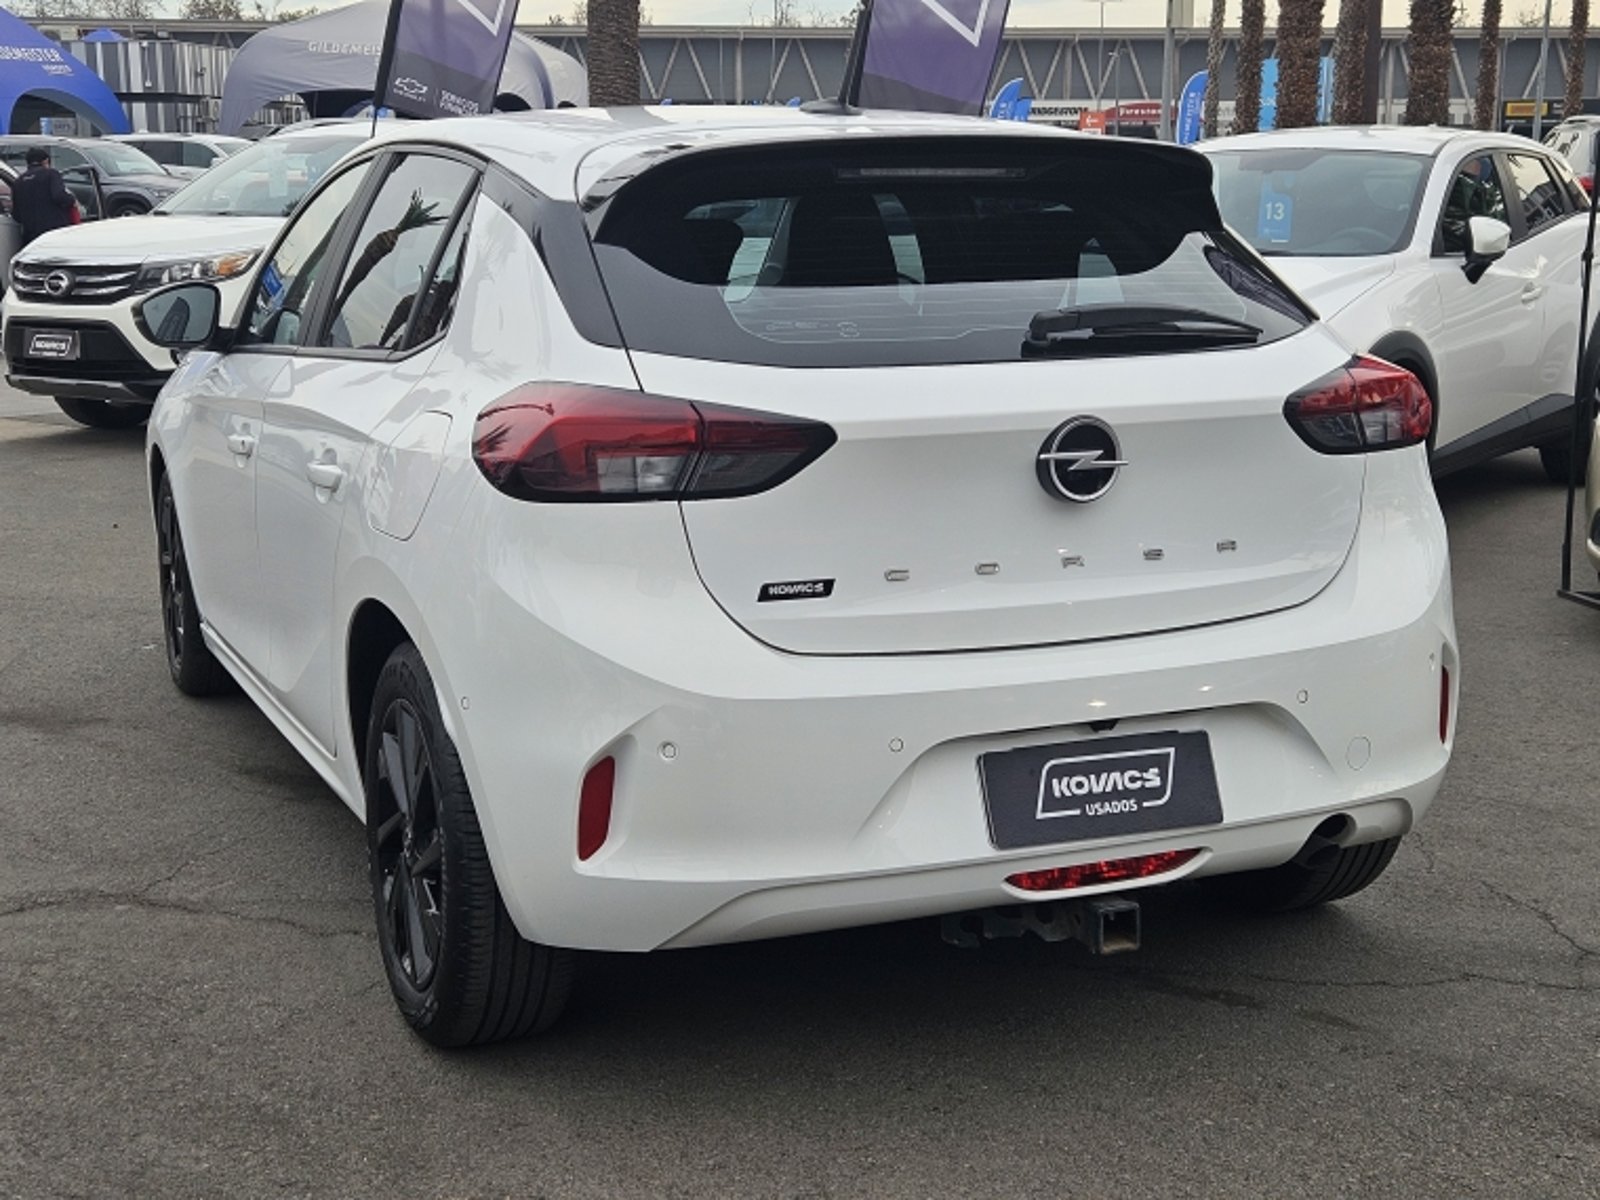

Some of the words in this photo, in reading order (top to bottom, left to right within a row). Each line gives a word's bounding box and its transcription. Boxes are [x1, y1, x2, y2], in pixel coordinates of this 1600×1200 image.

[308, 40, 382, 55] GILDEMEIS
[1264, 201, 1285, 220] 13
[767, 580, 825, 595] KOVACS
[1051, 767, 1162, 799] KOVACS
[1085, 799, 1138, 817] USADOS
